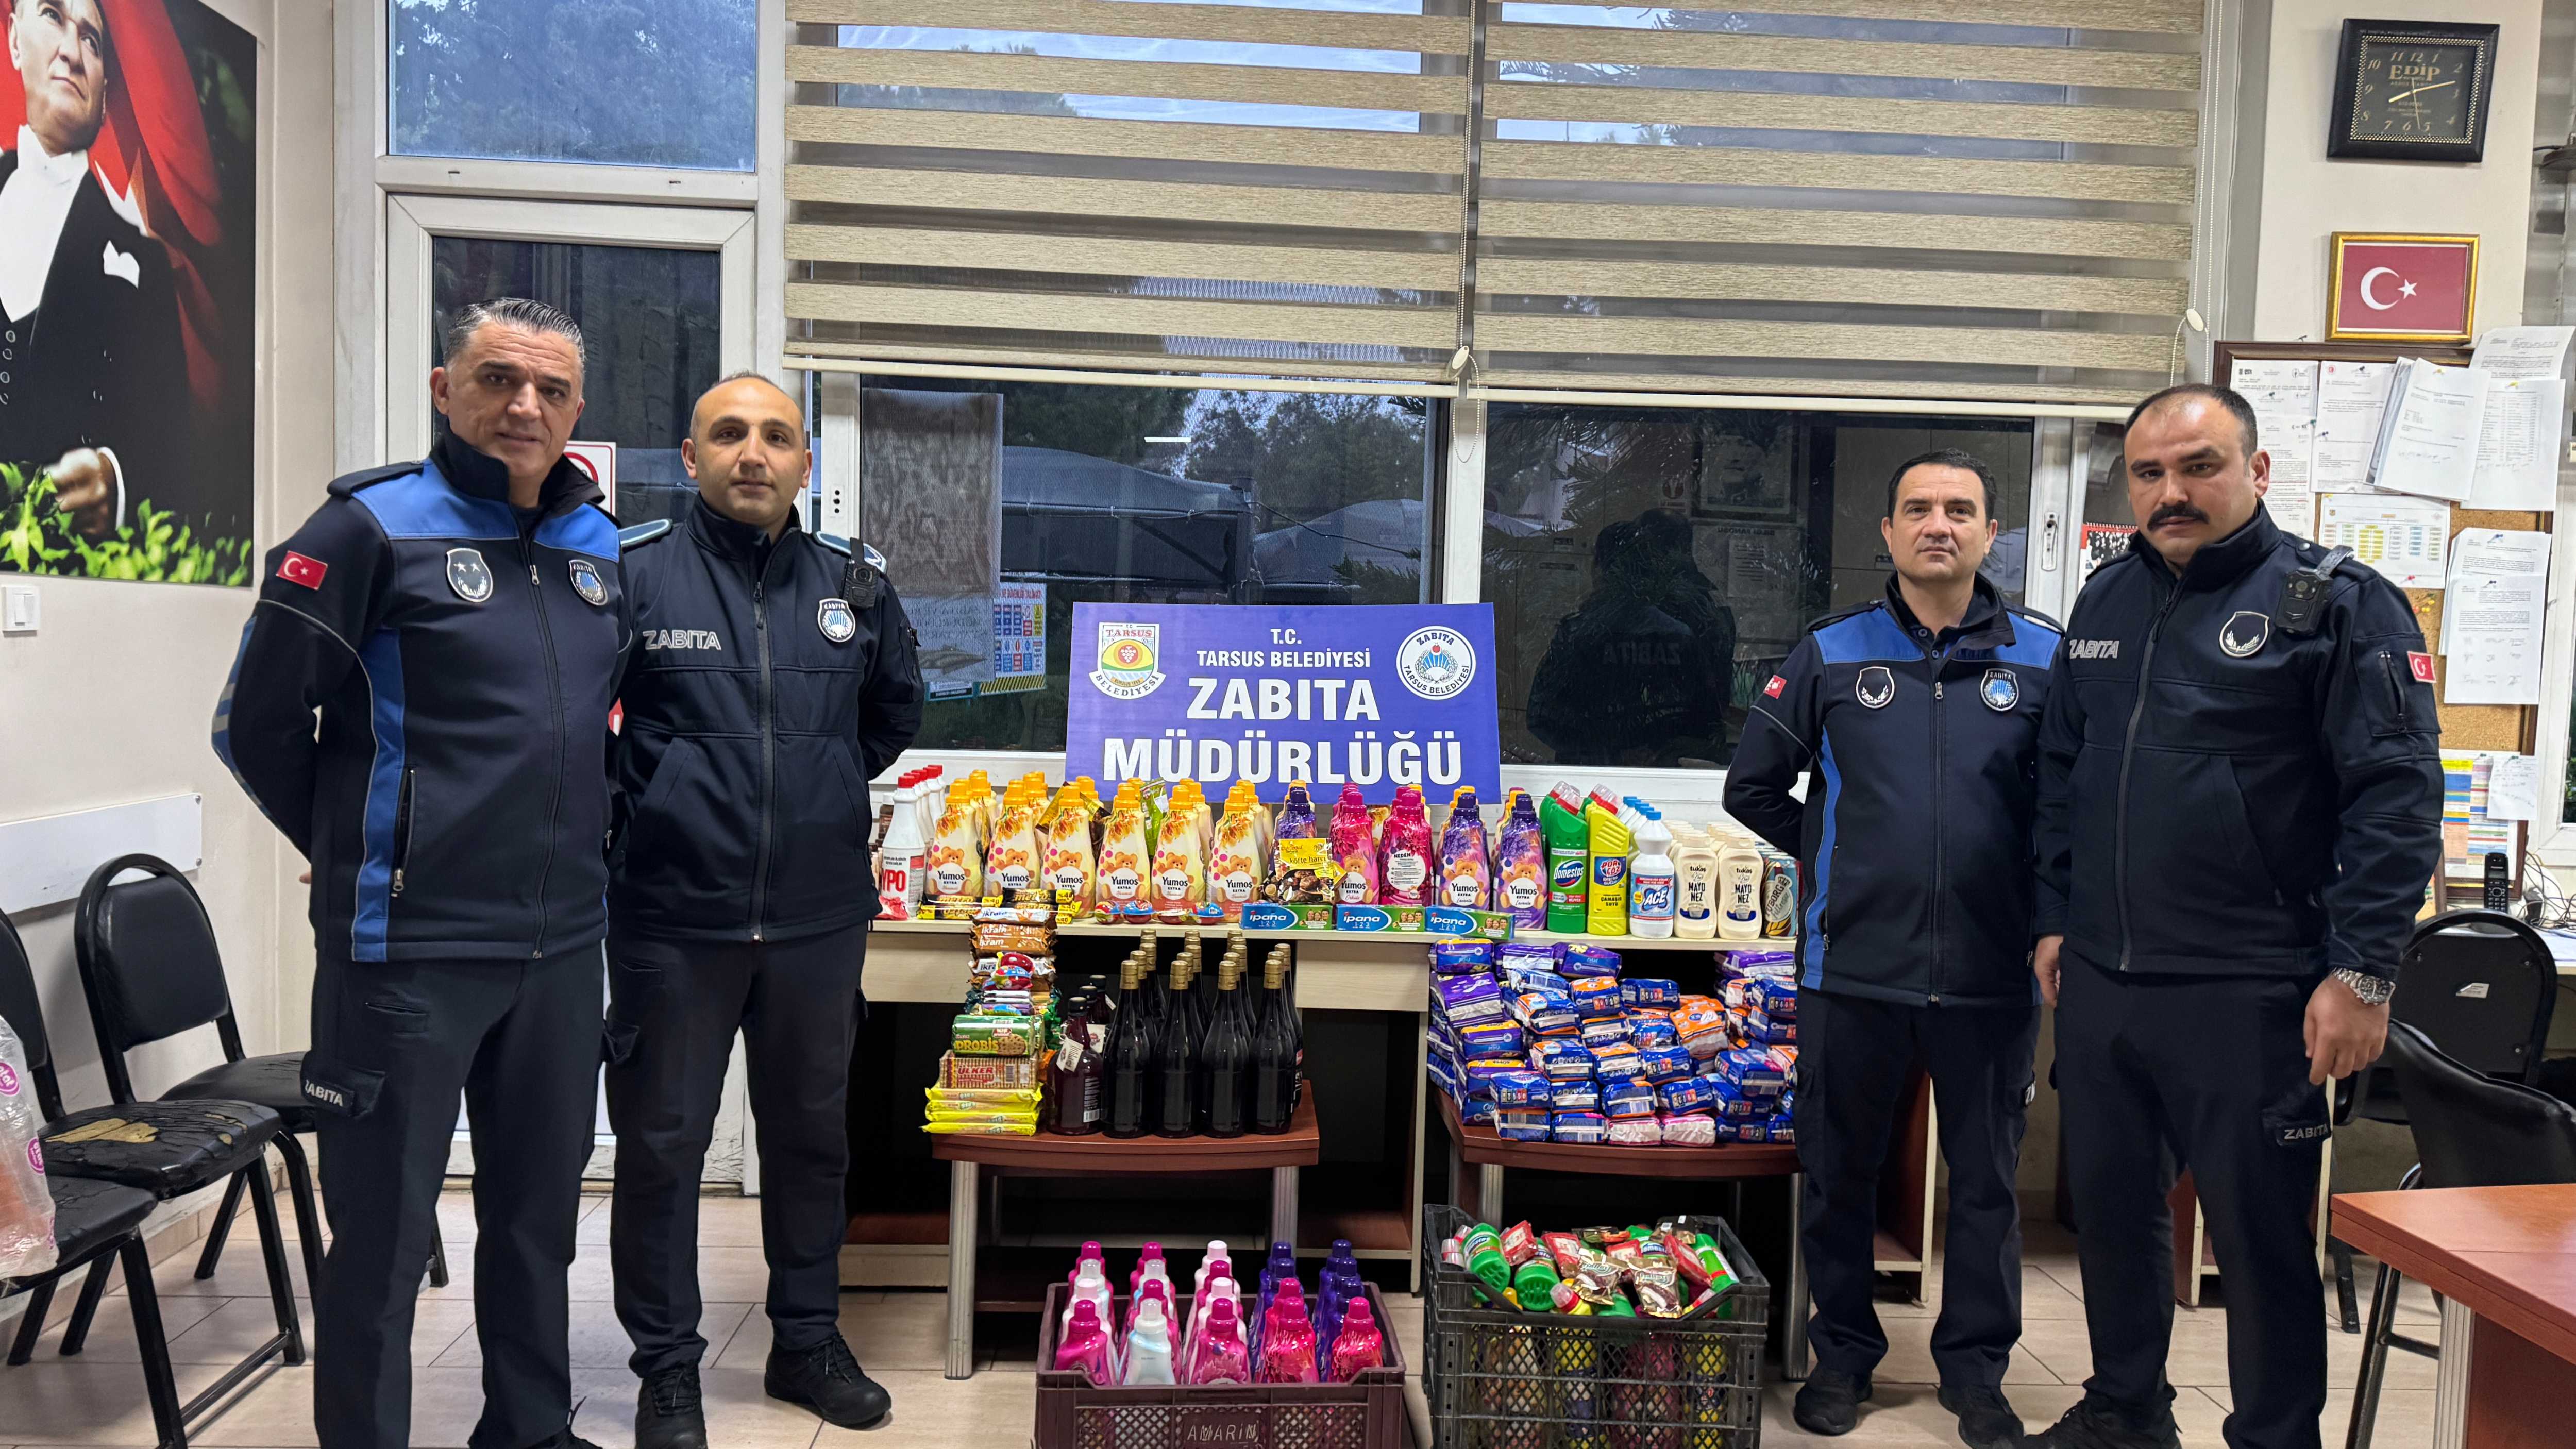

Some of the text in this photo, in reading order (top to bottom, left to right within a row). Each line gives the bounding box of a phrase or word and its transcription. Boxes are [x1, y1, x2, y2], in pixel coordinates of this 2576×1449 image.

[2390, 52, 2404, 61] 11
[2410, 53, 2424, 62] 12
[2432, 53, 2439, 63] 1
[2367, 59, 2381, 70] 10
[2453, 63, 2463, 73] 2
[2365, 84, 2373, 95] 9
[2452, 89, 2459, 99] 3
[2361, 111, 2370, 121] 8
[2384, 120, 2393, 130] 7
[2403, 121, 2412, 131] 6
[2423, 122, 2431, 132] 5
[1105, 629, 1152, 637] TARSUS
[1271, 628, 1302, 644] T.C.
[643, 629, 722, 650] ZABITA
[1416, 632, 1455, 646] ZABITA
[2069, 639, 2119, 659] ZABITA
[1197, 647, 1371, 668] TARSUS BELEDİYESİ
[1404, 665, 1428, 692] TARSUS
[1187, 678, 1380, 721] ZABITA
[1103, 729, 1462, 785] MÜDÜRLÜĞÜ
[1553, 867, 1584, 880] Domestos
[1688, 882, 1705, 892] MAYO
[1735, 884, 1752, 894] MAYO
[1644, 890, 1667, 905] ACE
[1691, 892, 1703, 902] NEZ
[1738, 894, 1749, 903] NEZ
[1249, 911, 1287, 921] ipana
[1343, 912, 1380, 923] ipana
[1430, 913, 1467, 926] ipana
[955, 1036, 999, 1051] PROBİS
[958, 1065, 994, 1074] ÜLKER
[2284, 1123, 2329, 1140] ZABITA
